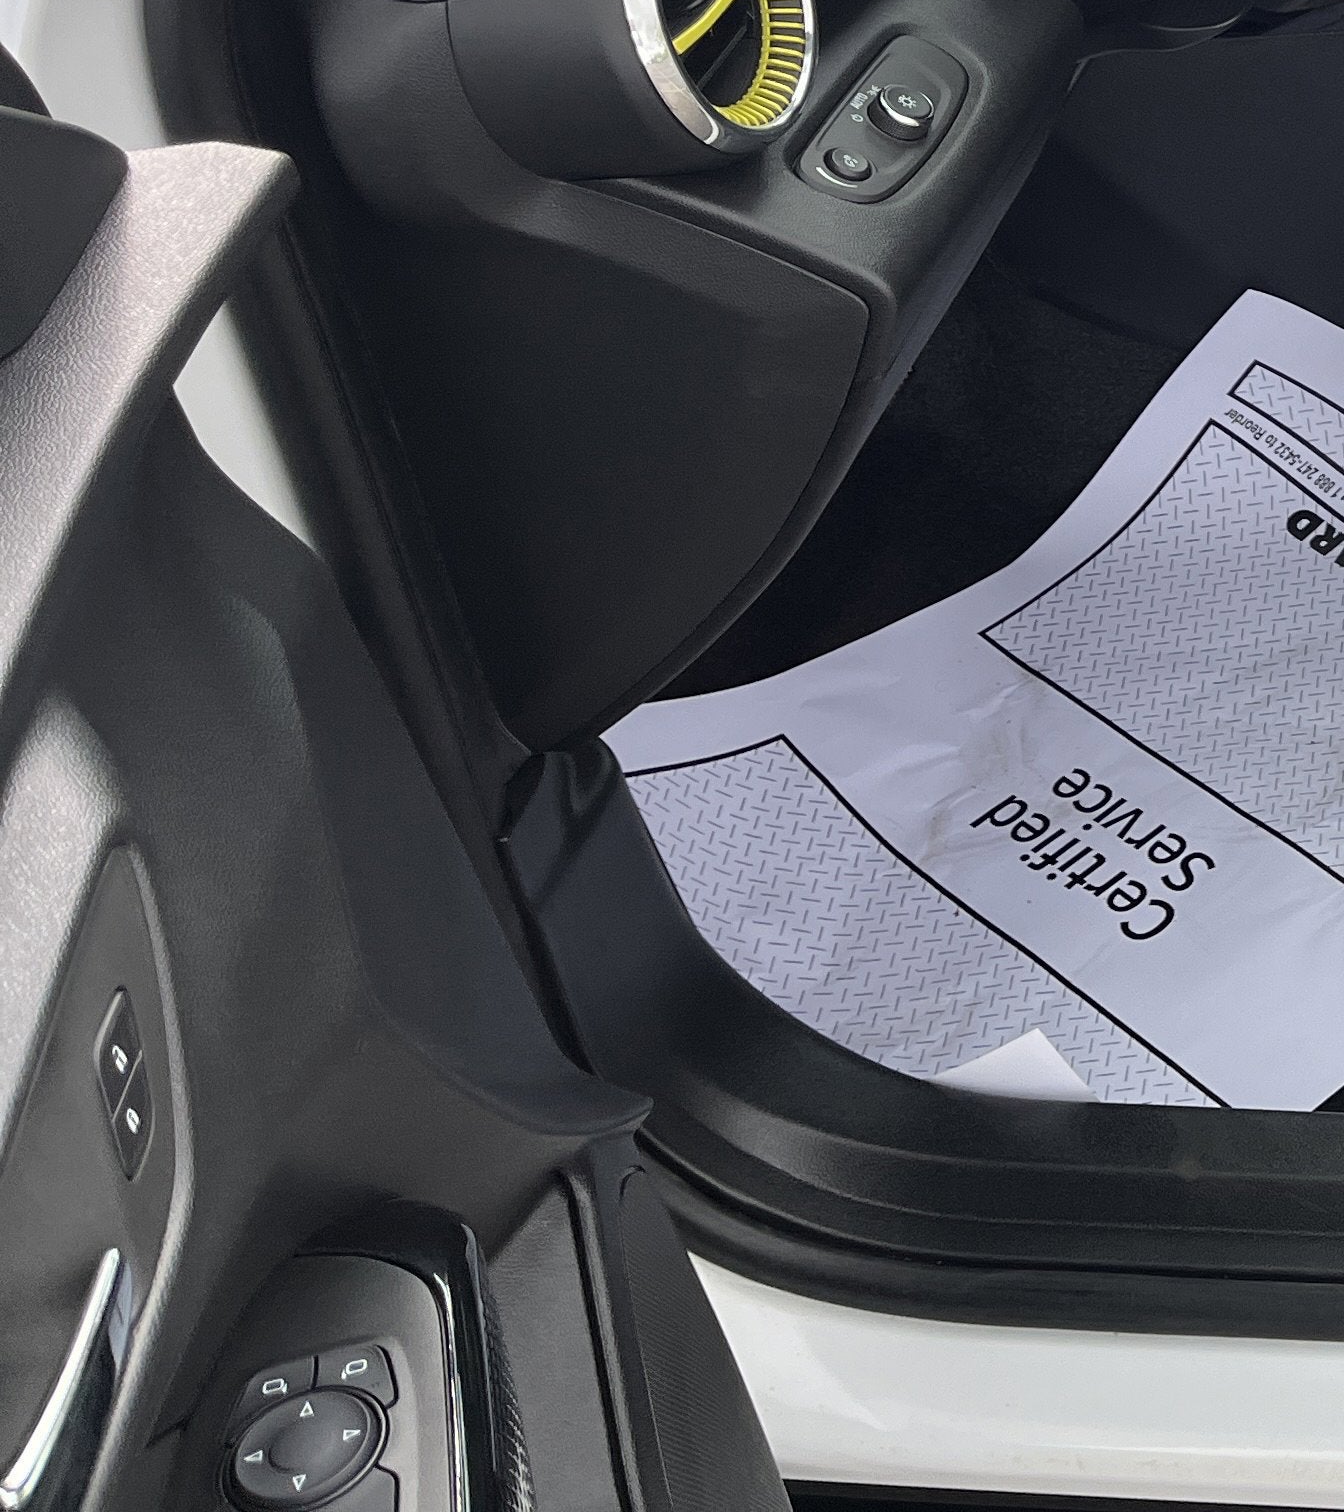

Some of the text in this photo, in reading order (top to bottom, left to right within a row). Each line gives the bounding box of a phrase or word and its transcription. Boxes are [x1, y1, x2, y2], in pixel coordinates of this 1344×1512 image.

[850, 92, 868, 109] AUTO
[1224, 408, 1267, 441] Reorder
[1266, 435, 1278, 448] to
[1274, 442, 1320, 480] 247-5432
[1314, 473, 1336, 494] 888
[1330, 487, 1342, 498] 1
[1052, 765, 1217, 893] Service
[970, 791, 1177, 941] Certified
